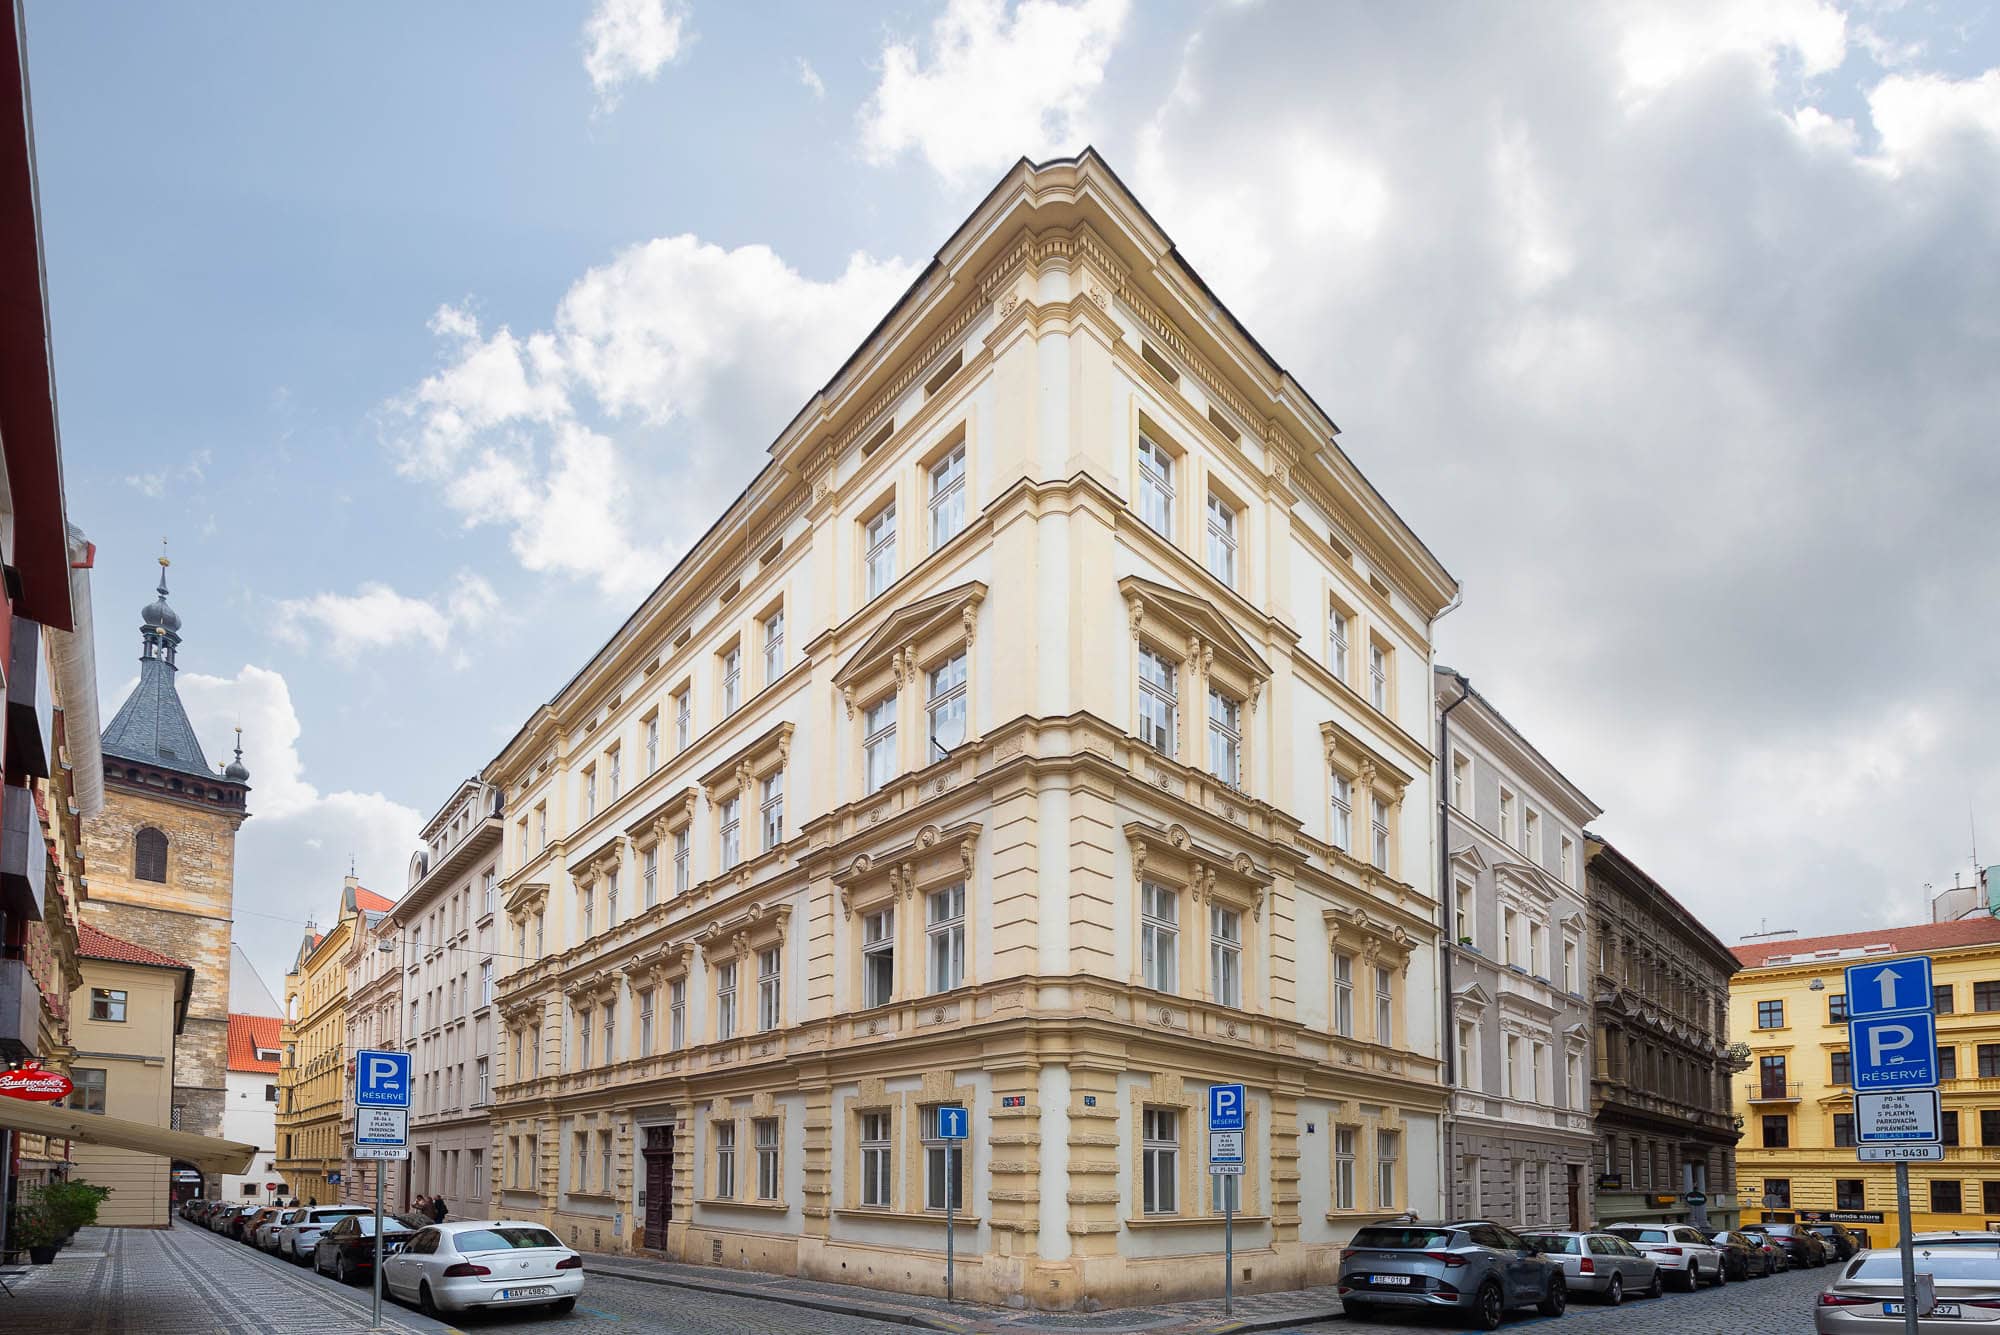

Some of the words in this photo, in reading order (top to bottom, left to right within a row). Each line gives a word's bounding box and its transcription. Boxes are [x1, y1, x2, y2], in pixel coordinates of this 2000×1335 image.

[1869, 1025, 1914, 1067] P
[0, 1076, 66, 1089] Budweiser
[369, 1058, 399, 1089] P
[1862, 1067, 1928, 1081] RÉSERVÉ
[1217, 1091, 1236, 1116] P
[1885, 1148, 1928, 1157] P1-0430
